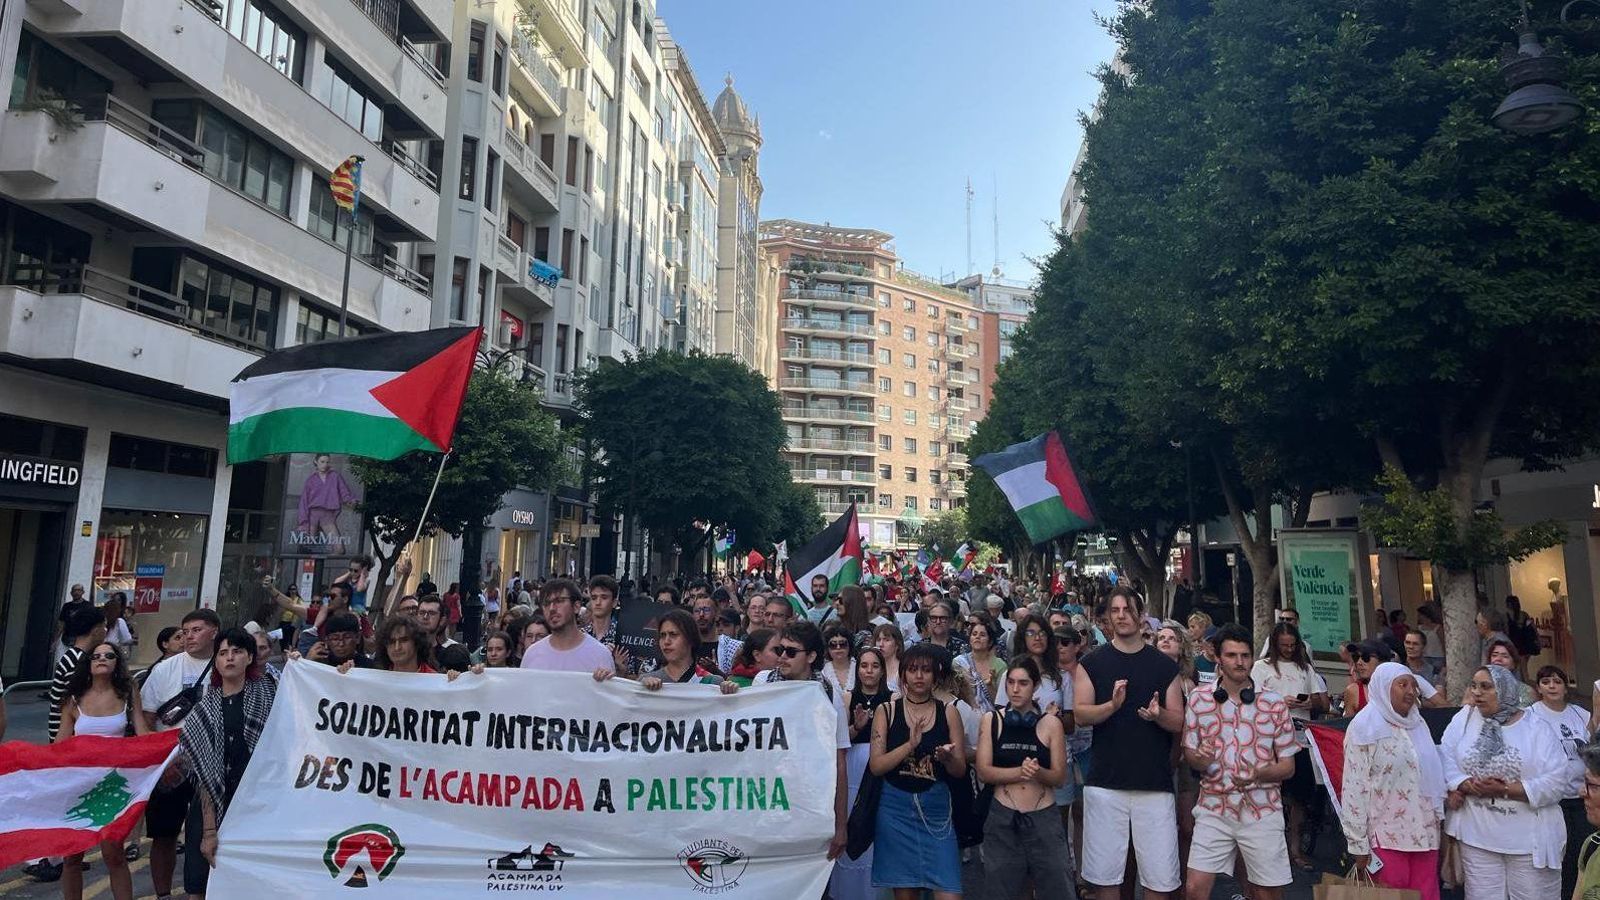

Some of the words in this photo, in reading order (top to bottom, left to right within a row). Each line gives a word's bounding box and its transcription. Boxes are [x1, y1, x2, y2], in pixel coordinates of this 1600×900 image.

[1, 459, 79, 485] INGFIELD
[512, 509, 534, 525] OYSHO
[1294, 564, 1325, 578] Verde
[620, 635, 655, 647] SILENCE
[315, 697, 481, 747] SOLIDARITAT
[486, 712, 789, 753] INTERNACIONALISTA
[294, 754, 353, 793] DES
[358, 761, 391, 798] DE
[400, 765, 584, 812] L'ACAMPADA
[593, 777, 616, 813] A
[627, 776, 790, 812] PALESTINA
[487, 873, 562, 882] ACAMPADA
[487, 882, 544, 891] PALESTINA
